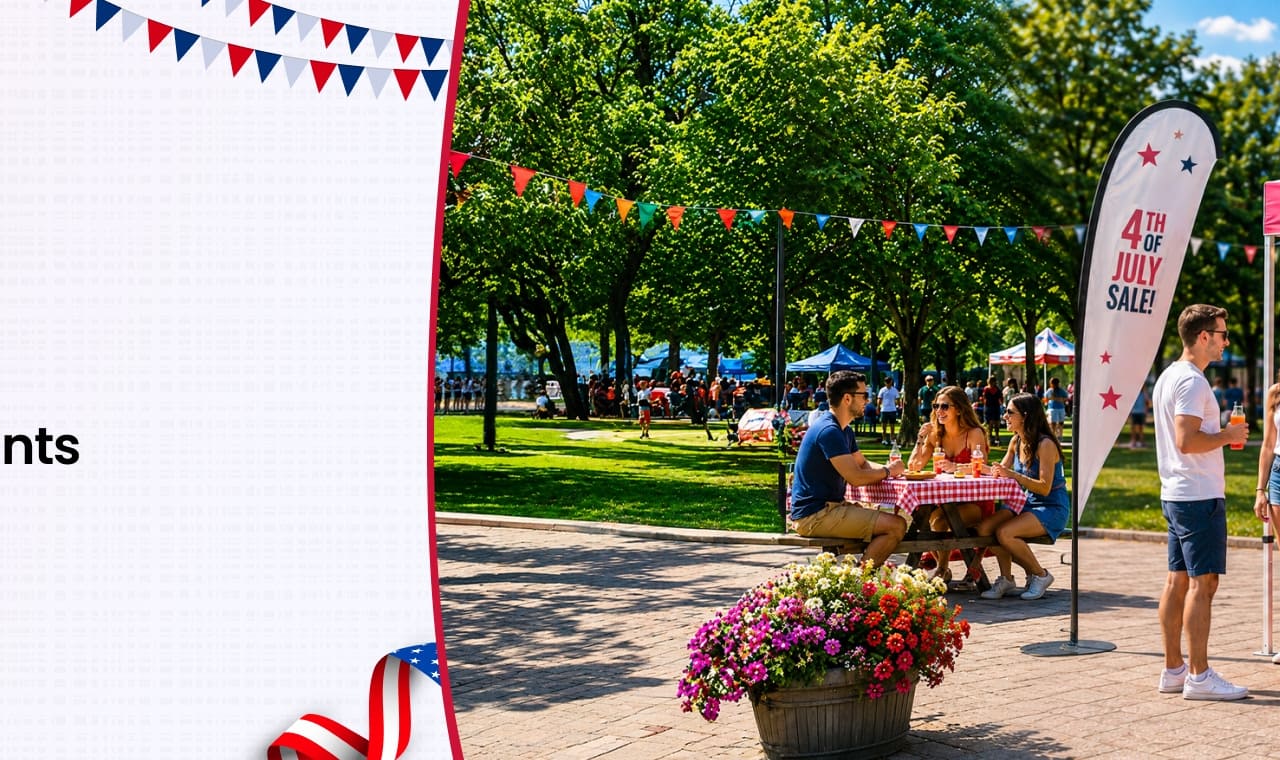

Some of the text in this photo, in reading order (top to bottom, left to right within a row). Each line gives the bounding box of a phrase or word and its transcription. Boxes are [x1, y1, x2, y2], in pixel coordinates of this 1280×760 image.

[1143, 233, 1163, 253] OF
[1111, 251, 1163, 286] JULY
[1106, 284, 1156, 315] SALE!
